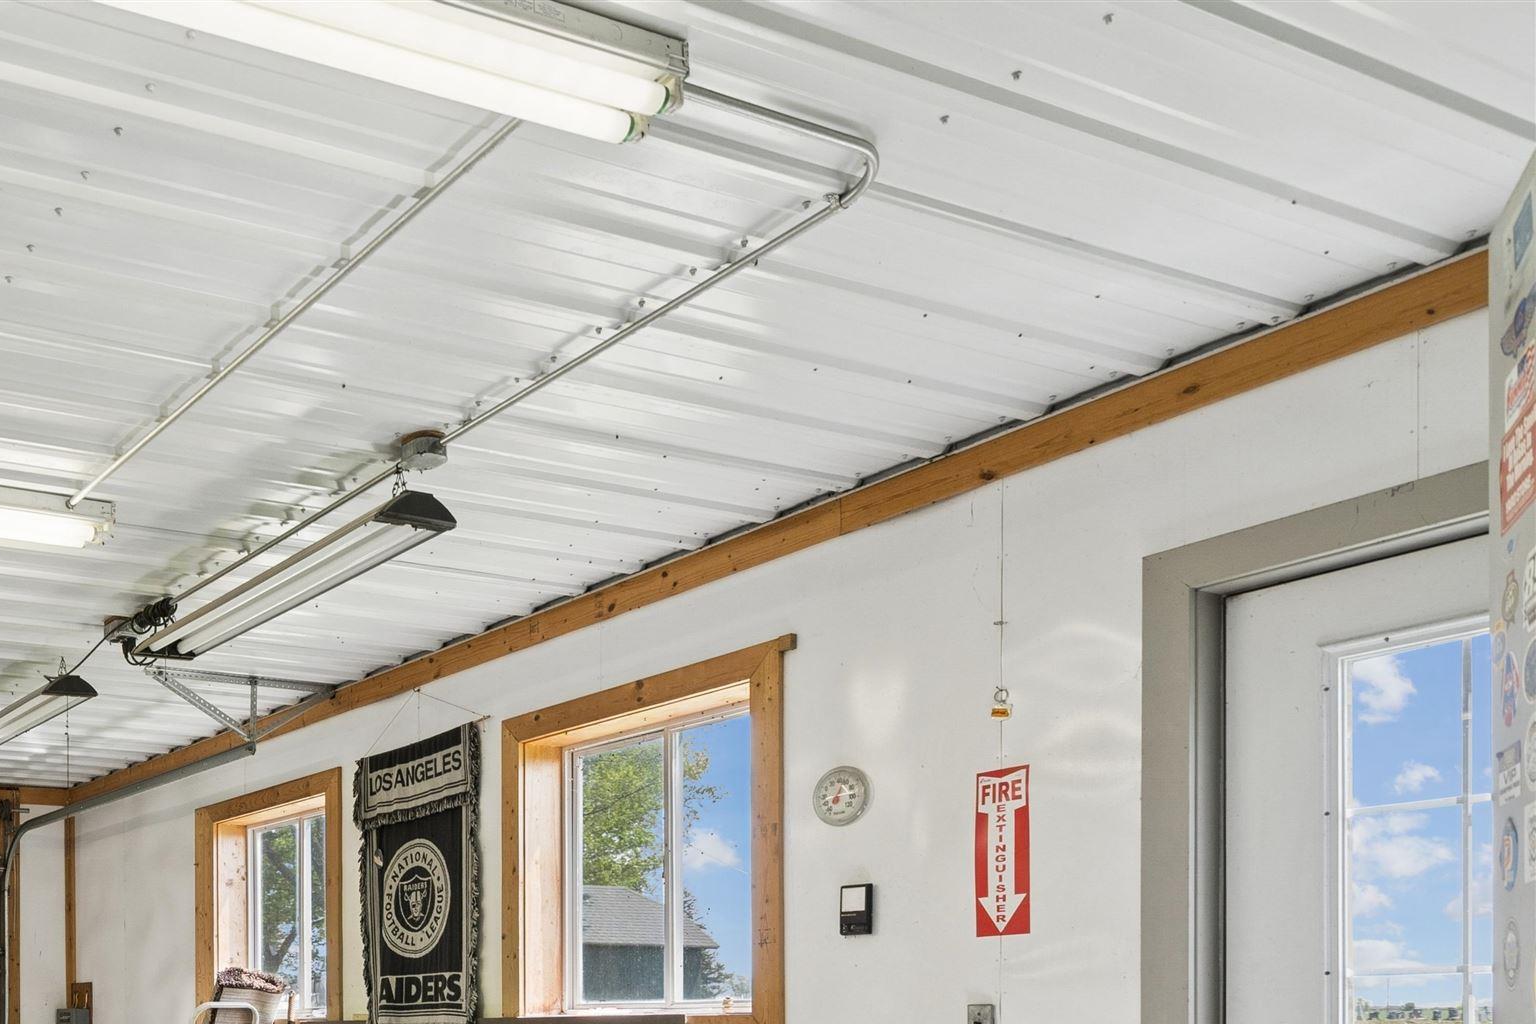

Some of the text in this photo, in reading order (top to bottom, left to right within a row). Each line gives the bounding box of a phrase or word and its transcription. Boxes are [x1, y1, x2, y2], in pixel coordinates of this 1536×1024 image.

[369, 750, 462, 796] LOS ANGELES
[981, 779, 1022, 805] FIRE
[391, 851, 438, 882] NATIONAL
[995, 804, 1006, 922] EXTINGUISHER
[385, 884, 444, 946] FOOTBALL LEAGUE
